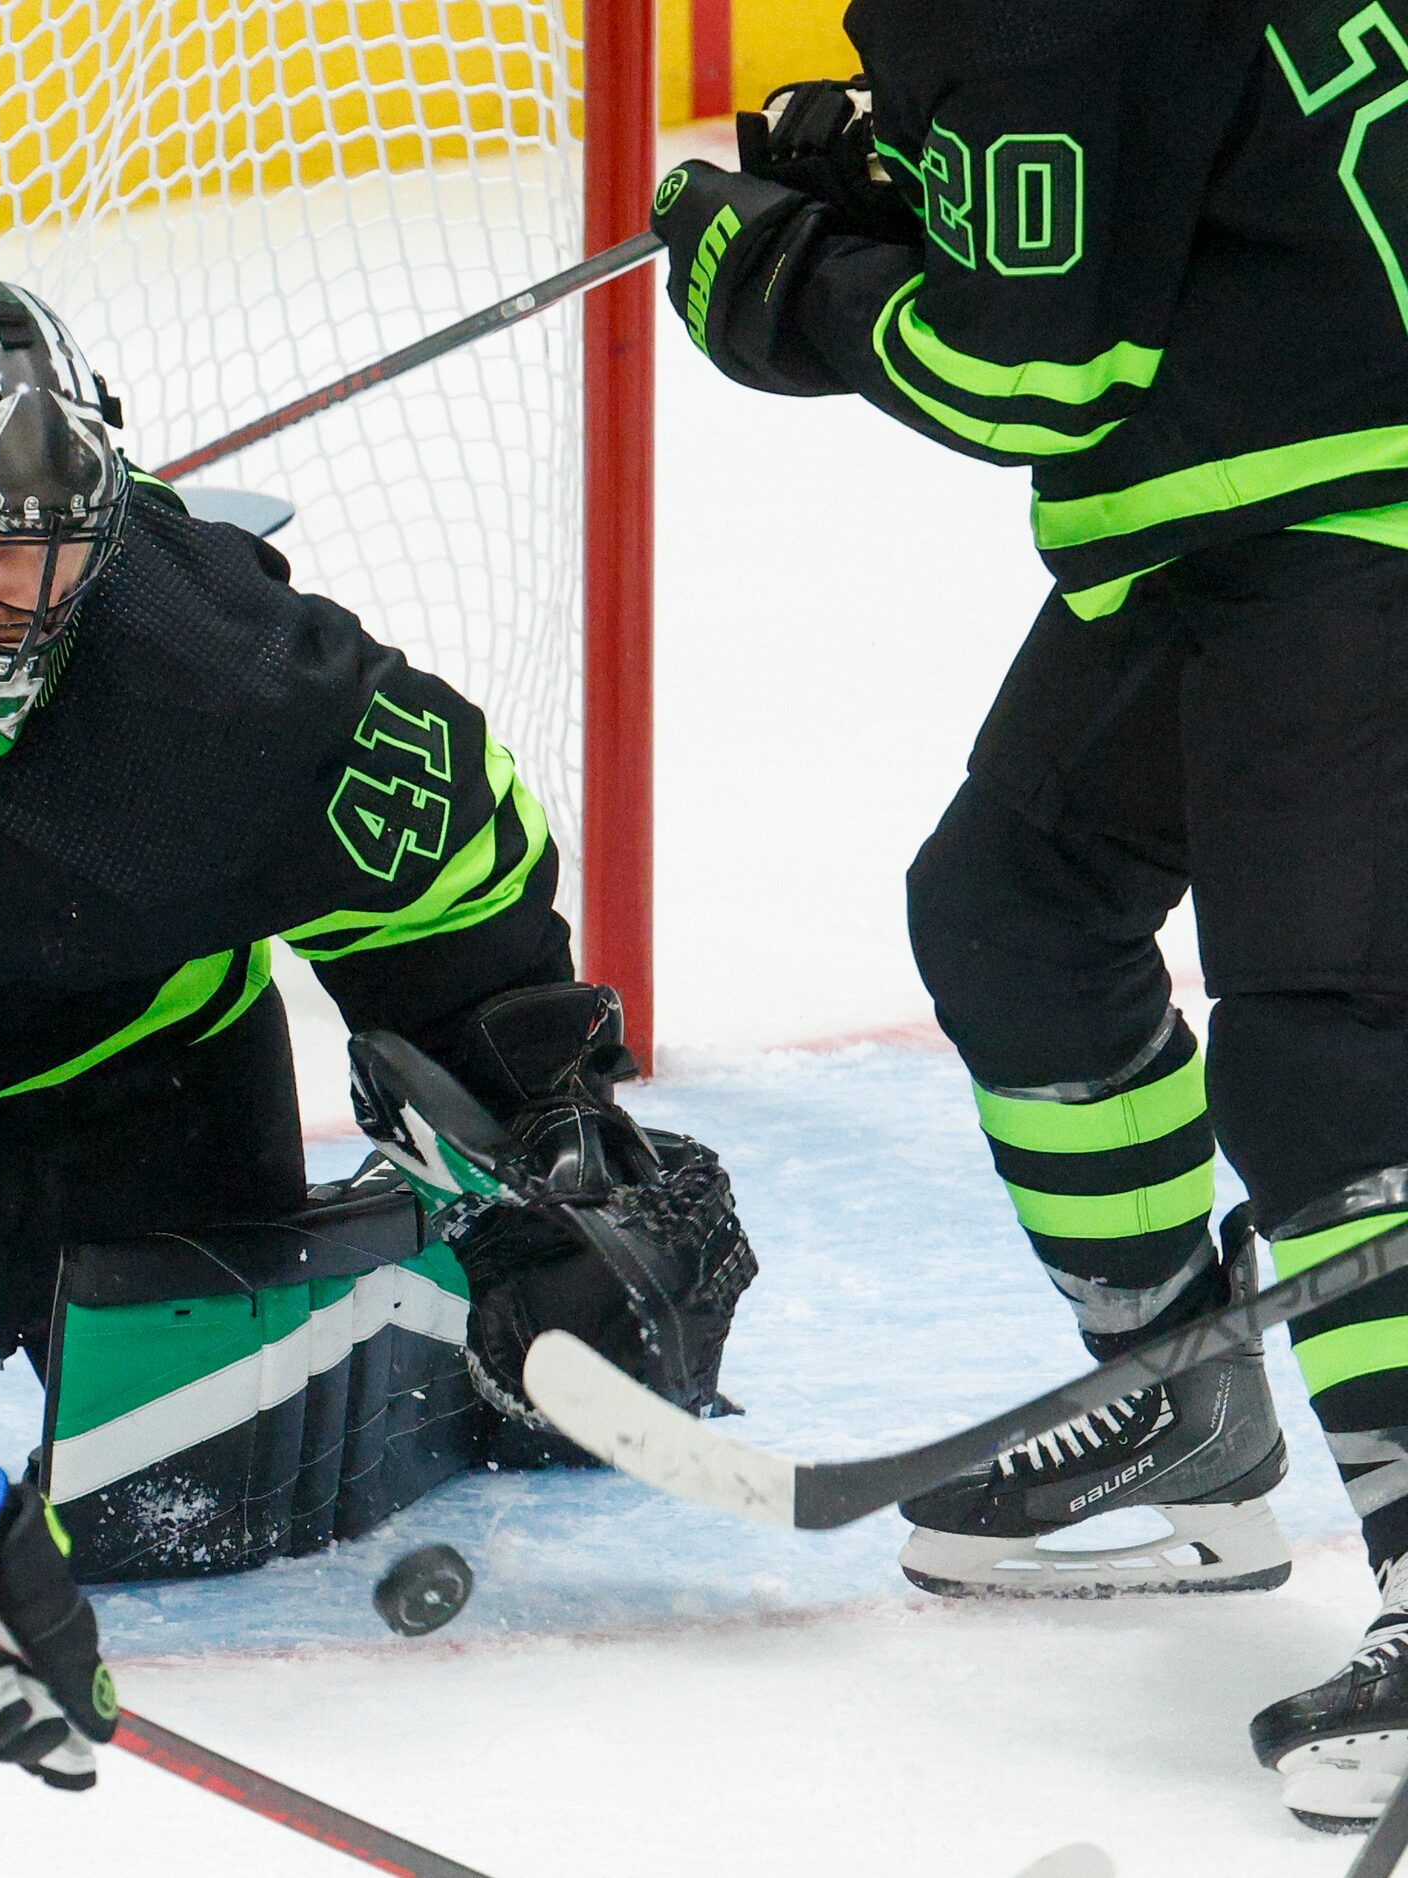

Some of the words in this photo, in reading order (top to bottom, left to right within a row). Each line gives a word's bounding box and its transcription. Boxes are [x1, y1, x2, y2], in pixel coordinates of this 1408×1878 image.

[920, 118, 1084, 277] 20
[327, 689, 452, 882] 41
[1069, 1454, 1156, 1513] BAUER
